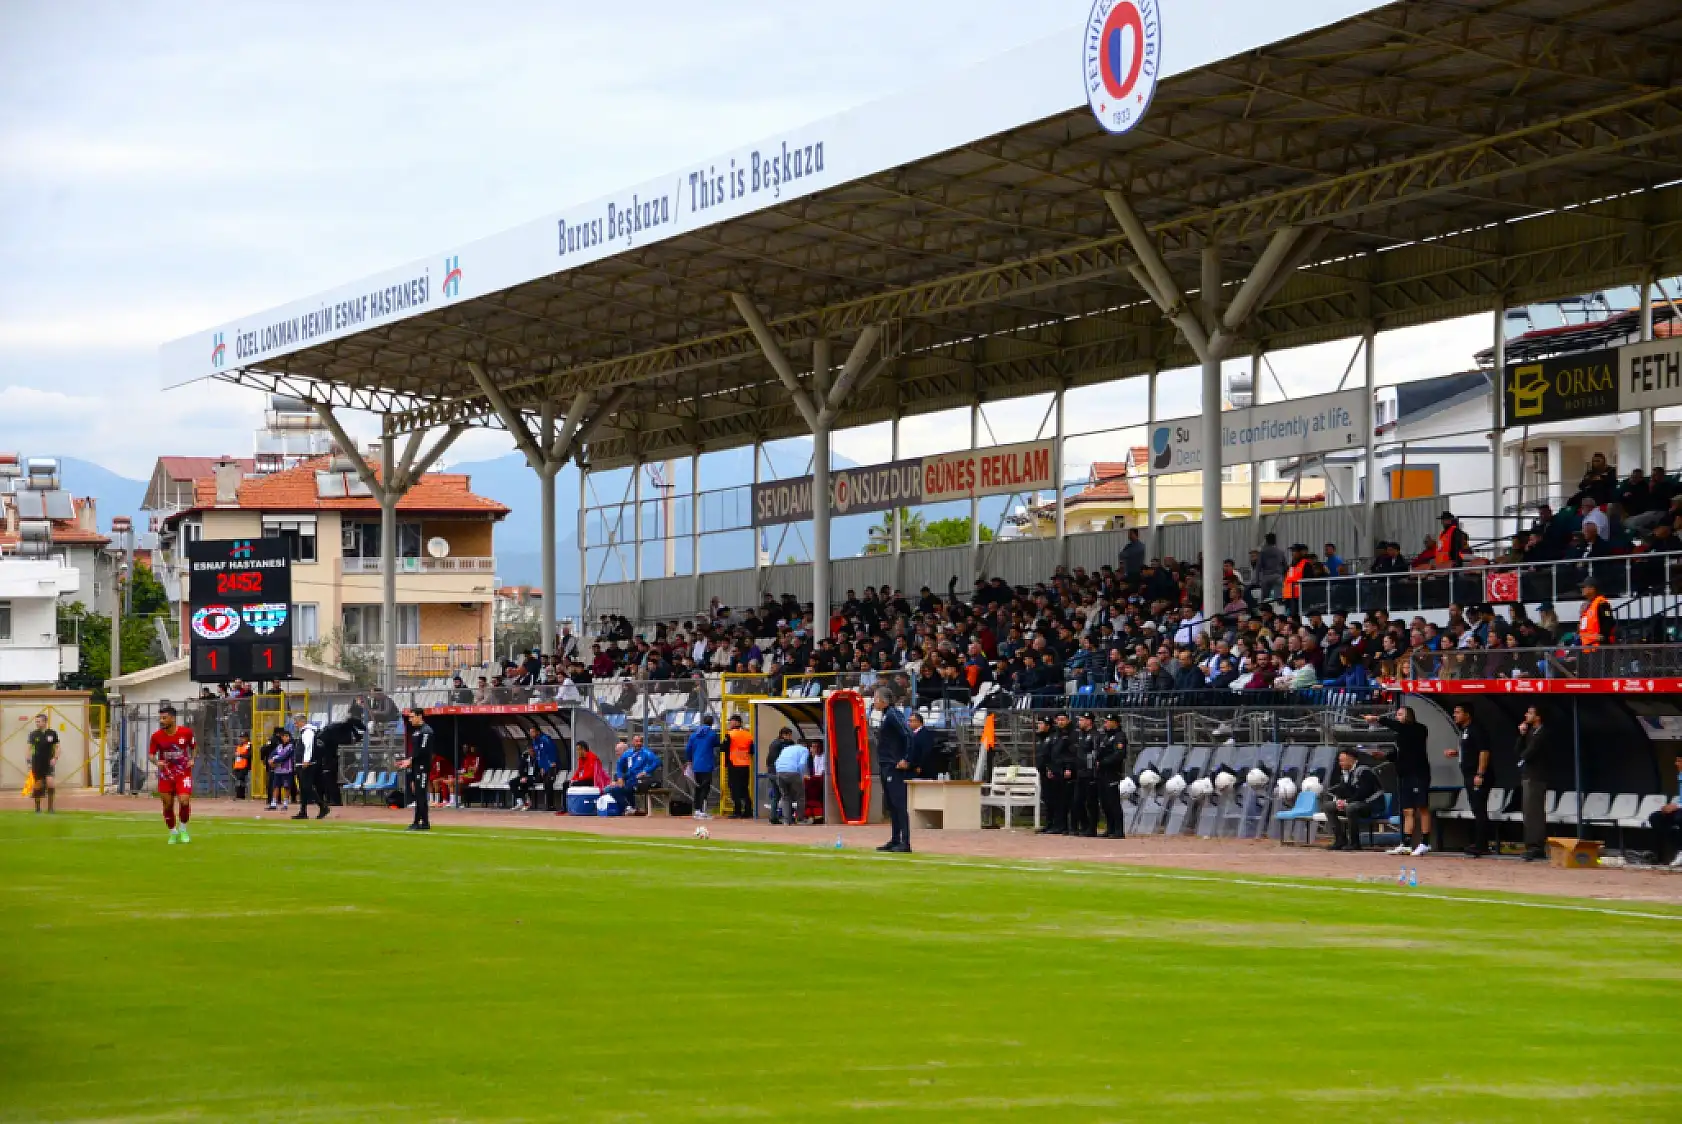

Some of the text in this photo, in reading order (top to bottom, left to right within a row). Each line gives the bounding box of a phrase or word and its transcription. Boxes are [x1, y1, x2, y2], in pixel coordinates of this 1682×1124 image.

[557, 217, 603, 256] Burası
[607, 194, 669, 246] Beşkaza
[688, 165, 725, 213] This
[730, 158, 745, 200] is
[751, 140, 824, 198] Beşkaza
[235, 266, 430, 360] ÖZEL LOKMAN HEKİM ESNAF HASTANESİ
[1555, 363, 1614, 397] ORKA
[1630, 351, 1680, 393] FETH
[1222, 407, 1352, 447] ile confidently at life.
[925, 448, 1050, 498] GÜNEŞ REKLAM
[1176, 448, 1201, 466] Dent
[757, 485, 813, 520] SEVDAM
[193, 557, 285, 571] ESNAF HASTANESİ
[206, 649, 217, 671] 1
[263, 648, 273, 669] 1
